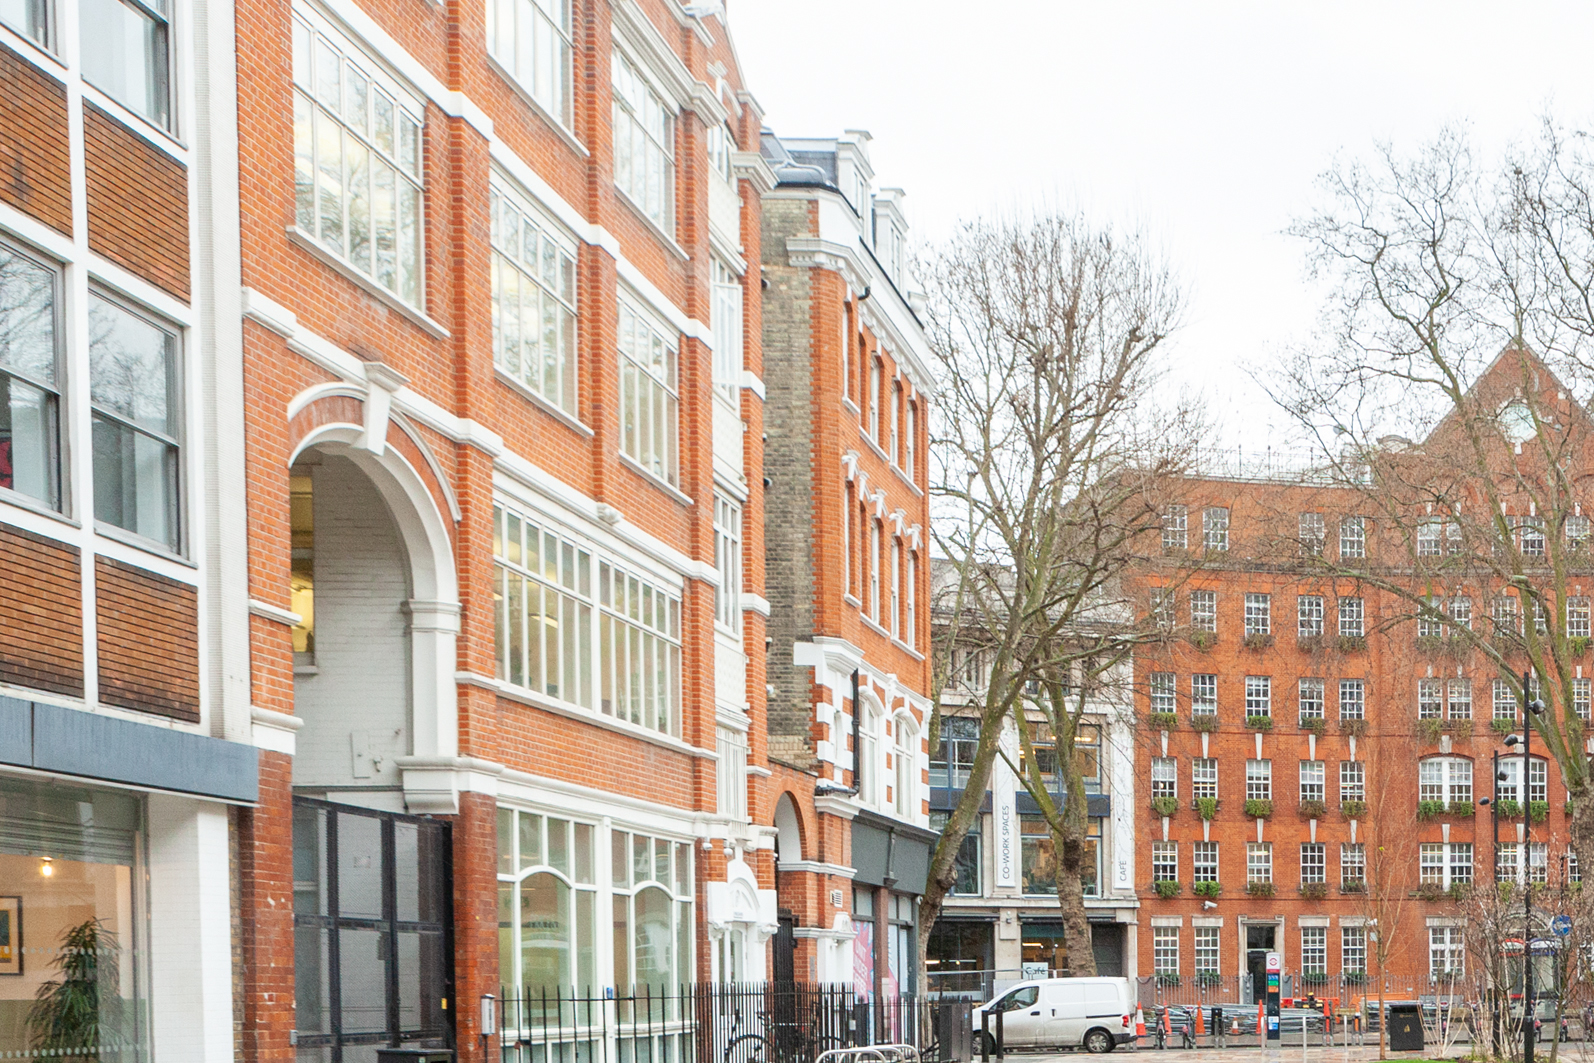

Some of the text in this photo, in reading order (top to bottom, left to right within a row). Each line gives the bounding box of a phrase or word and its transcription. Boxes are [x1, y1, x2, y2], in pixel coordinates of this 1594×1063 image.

[1002, 805, 1010, 880] CO-WORK SPACES
[1119, 860, 1127, 882] CAFÉ
